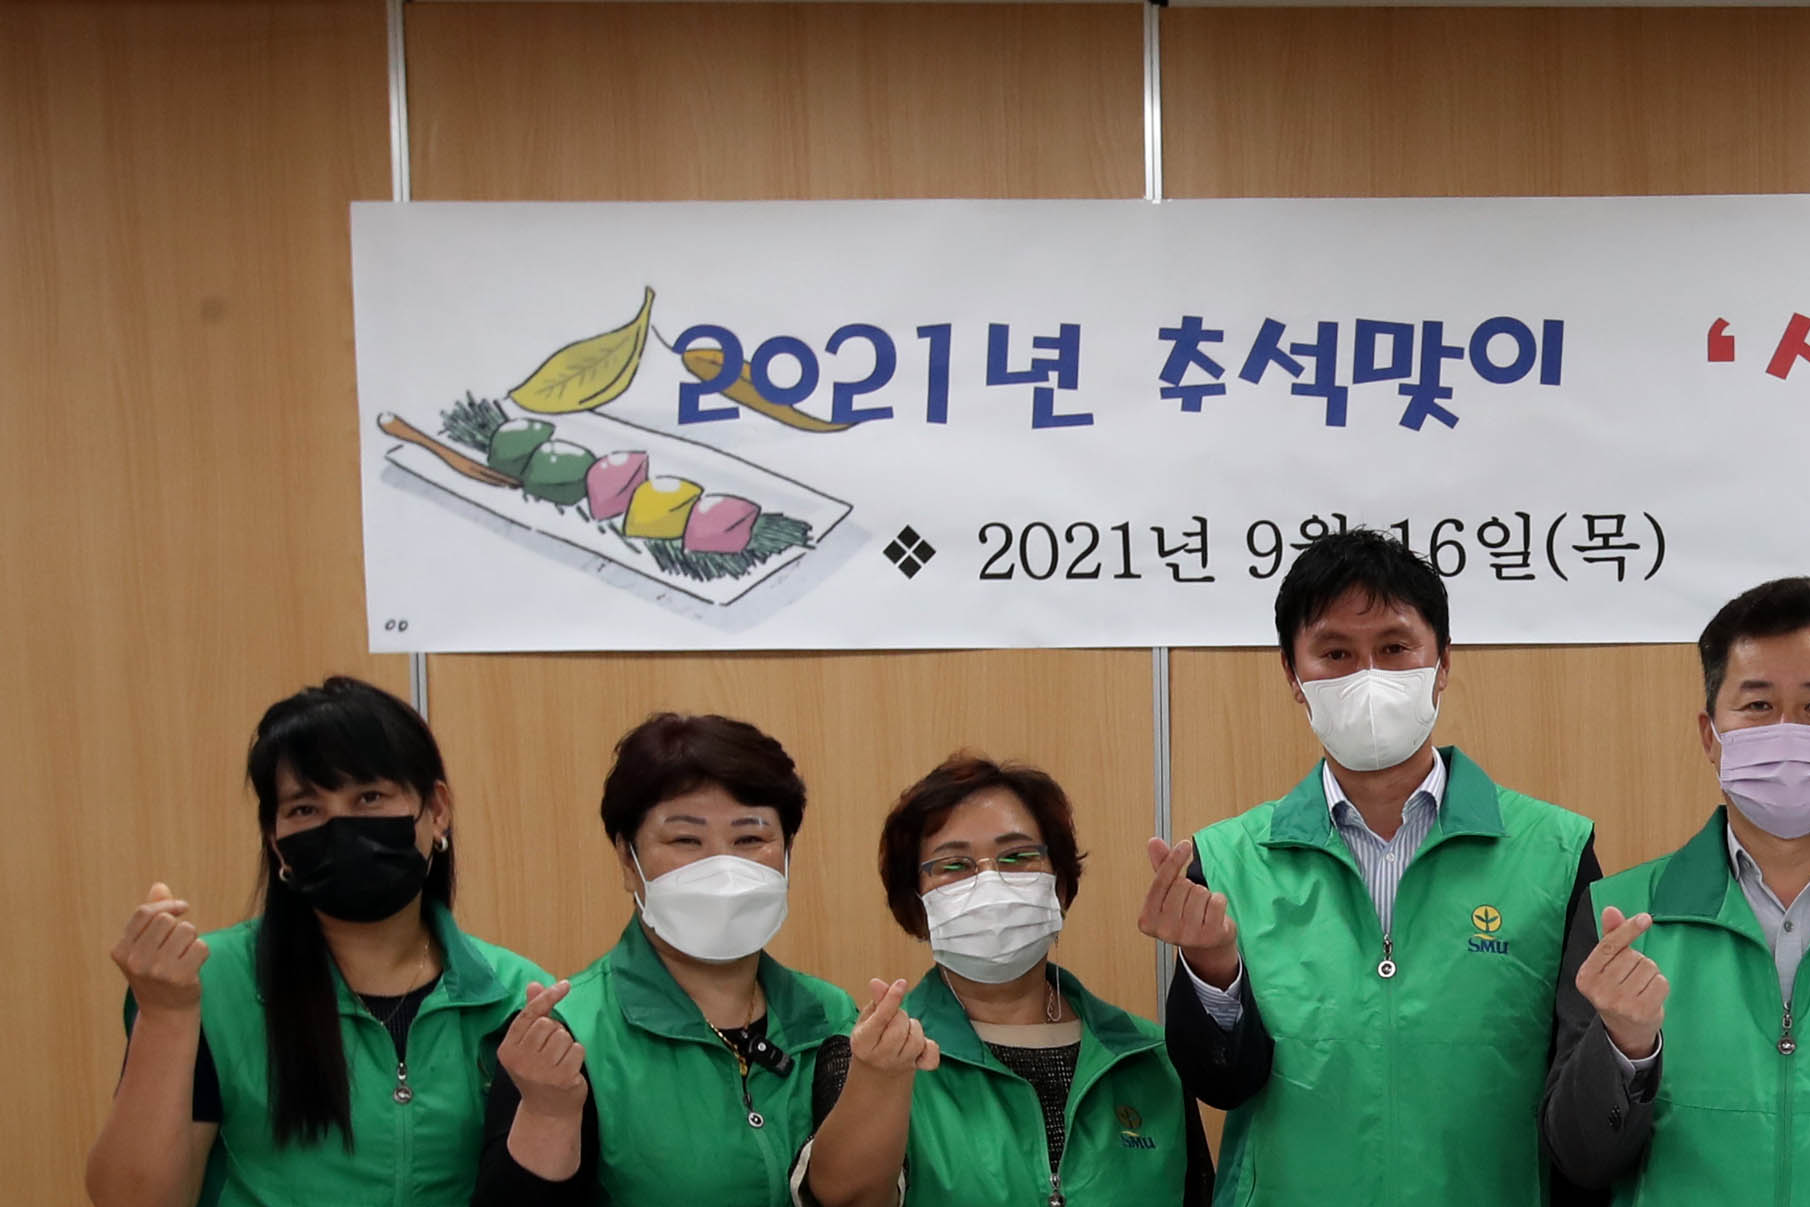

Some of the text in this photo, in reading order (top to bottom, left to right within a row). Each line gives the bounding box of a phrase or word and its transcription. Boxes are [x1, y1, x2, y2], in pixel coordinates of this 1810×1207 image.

[671, 323, 1094, 429] 2021년
[1161, 317, 1563, 430] 추석맞이
[978, 515, 1215, 583] 2021년
[1468, 938, 1509, 954] SMU
